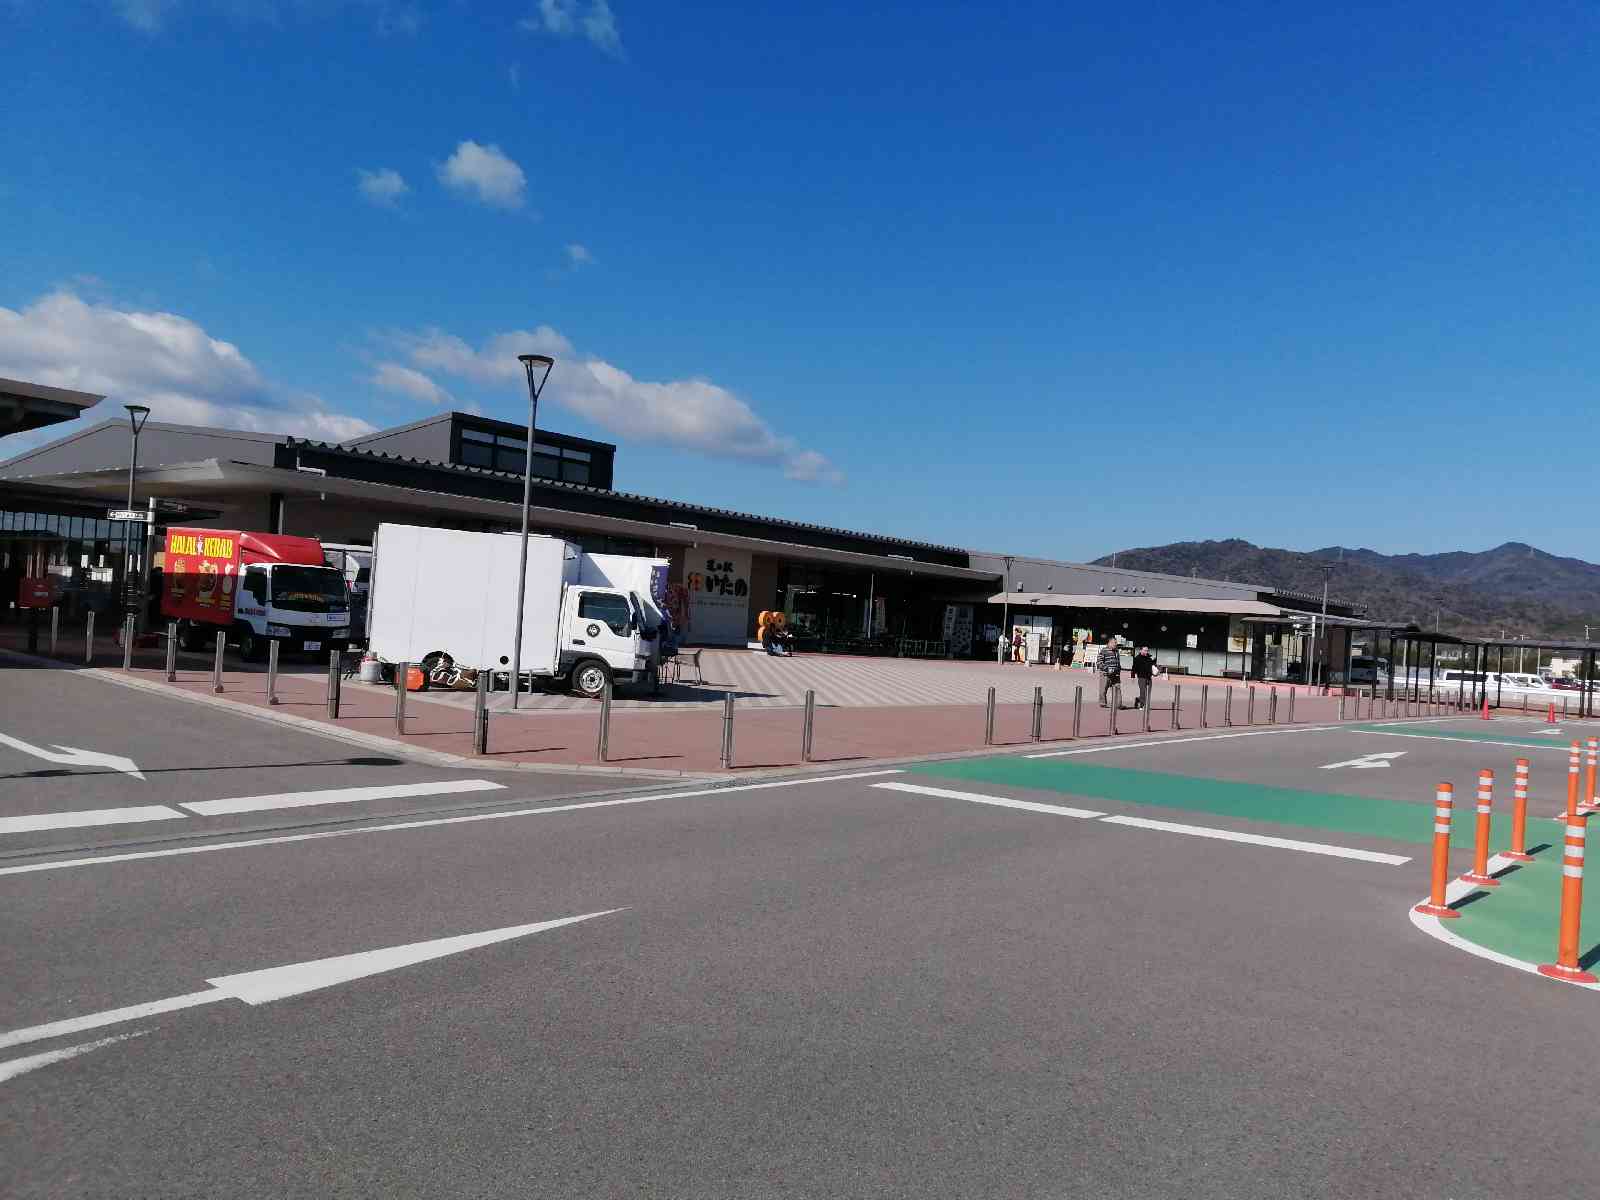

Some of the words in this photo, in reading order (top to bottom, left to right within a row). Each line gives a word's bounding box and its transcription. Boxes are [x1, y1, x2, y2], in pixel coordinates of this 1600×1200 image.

[170, 535, 197, 555] HALAL
[204, 537, 233, 558] KEBAB
[706, 574, 747, 597] いたの
